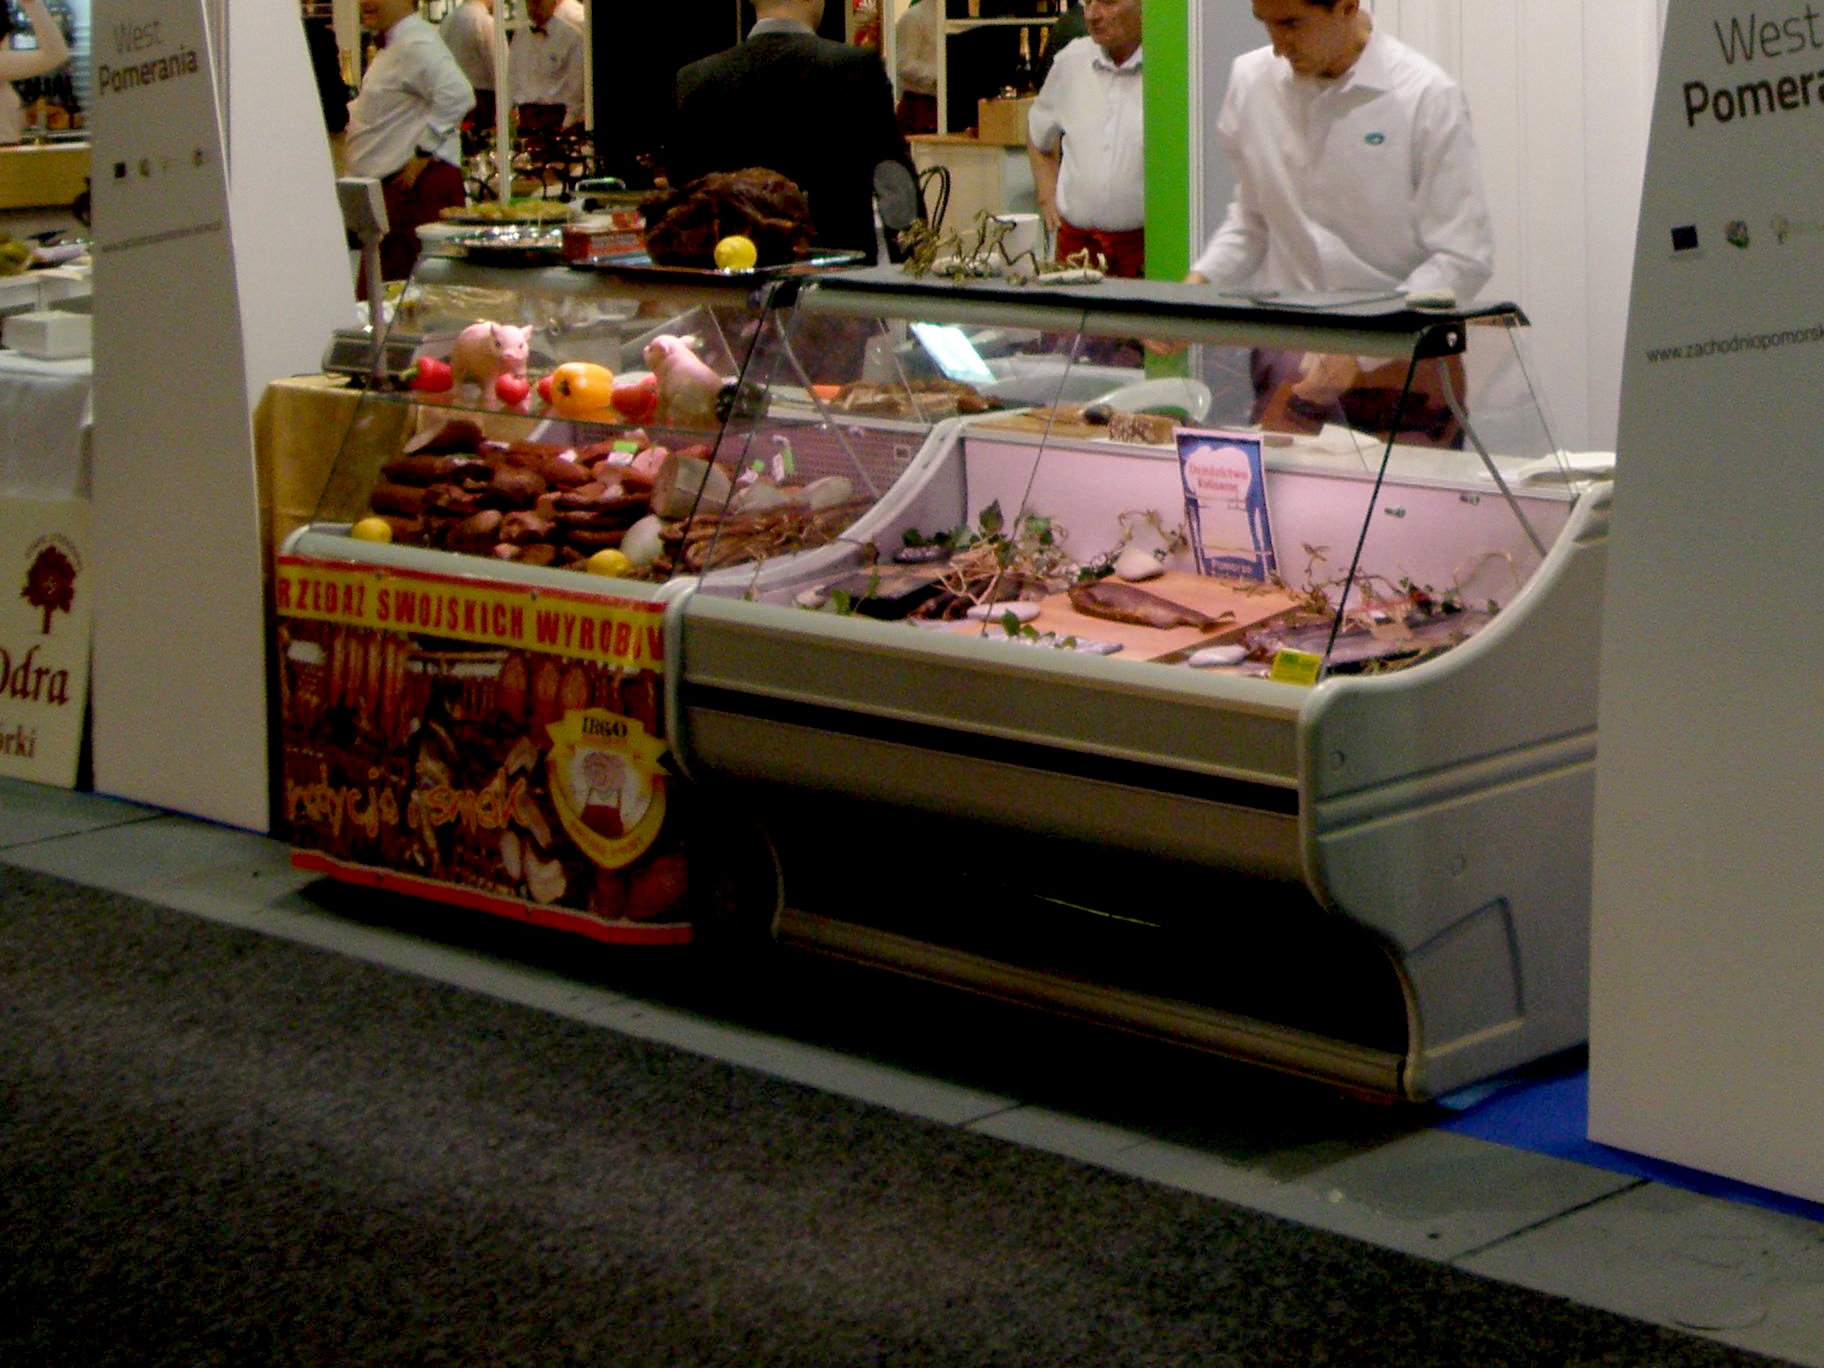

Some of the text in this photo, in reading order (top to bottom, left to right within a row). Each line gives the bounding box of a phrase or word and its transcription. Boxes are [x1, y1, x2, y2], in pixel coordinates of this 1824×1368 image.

[112, 18, 162, 56] West
[1713, 3, 1824, 65] West
[99, 43, 198, 96] Pomerania
[376, 587, 524, 641] SWOJSKICH
